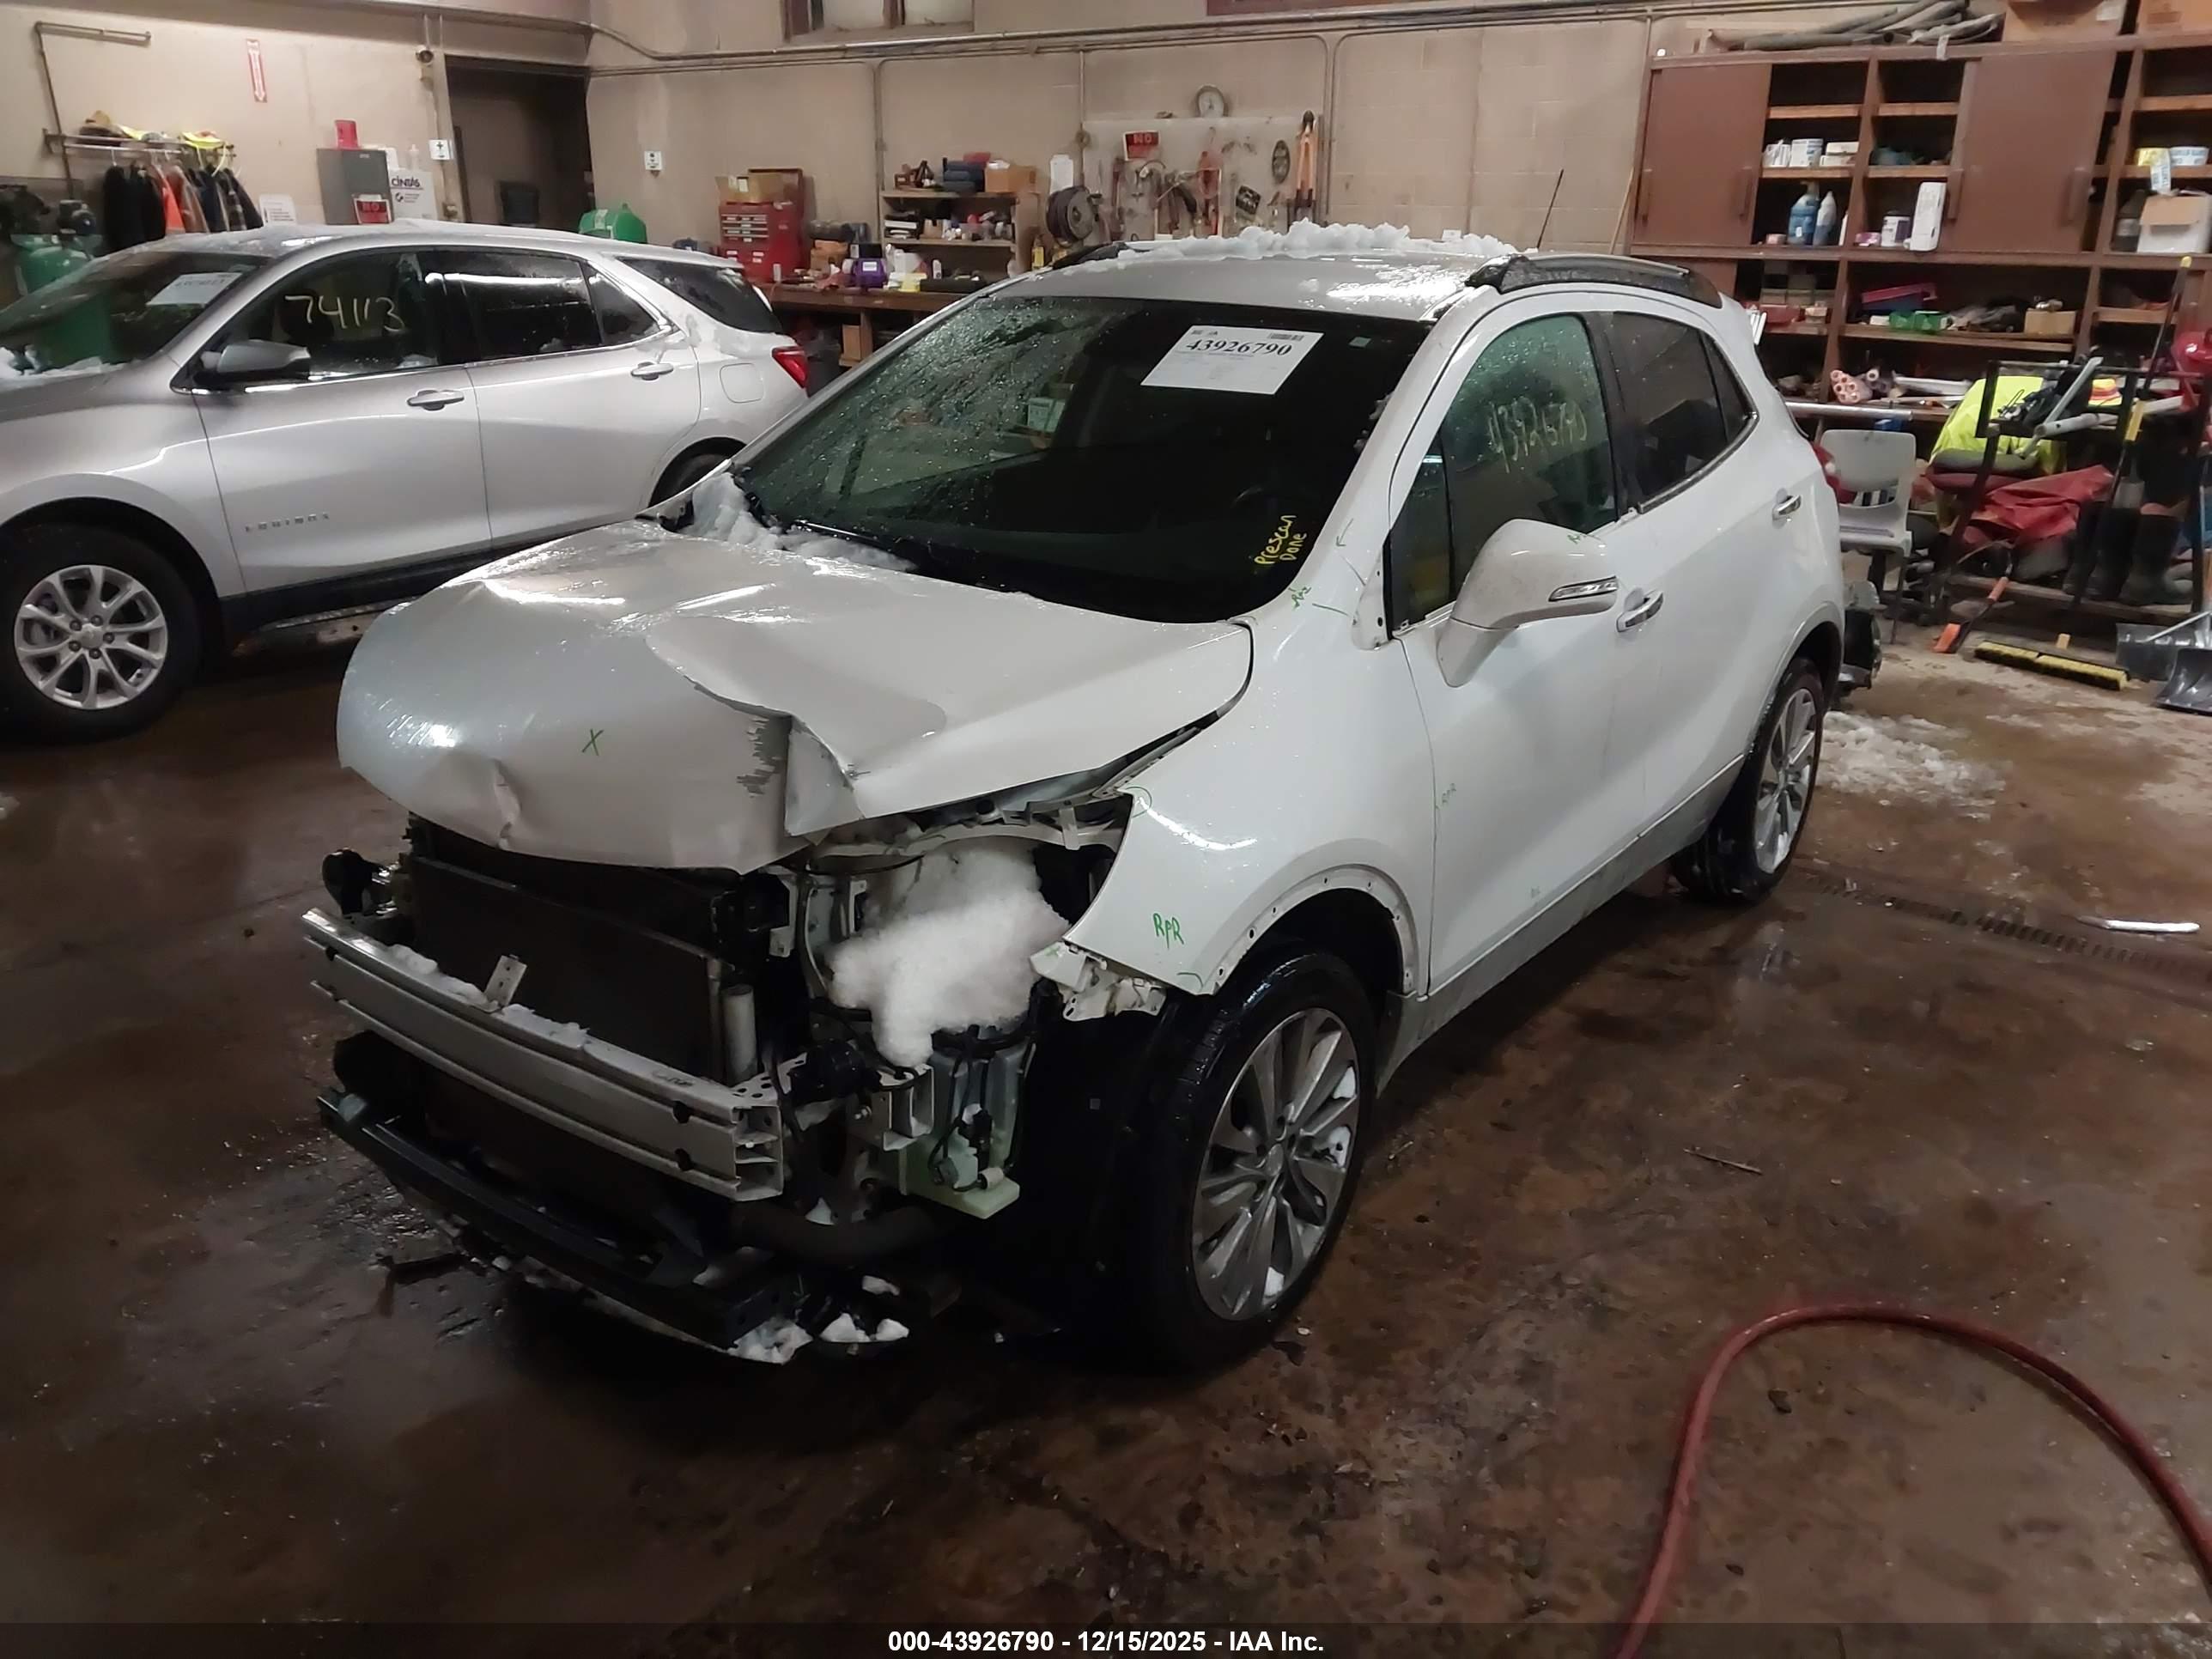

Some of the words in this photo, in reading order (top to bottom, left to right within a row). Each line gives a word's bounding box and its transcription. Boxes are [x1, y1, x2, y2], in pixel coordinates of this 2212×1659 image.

[1133, 133, 1152, 143] NO
[285, 295, 405, 331] 74113
[1186, 338, 1292, 356] 43926790
[581, 727, 605, 757] X
